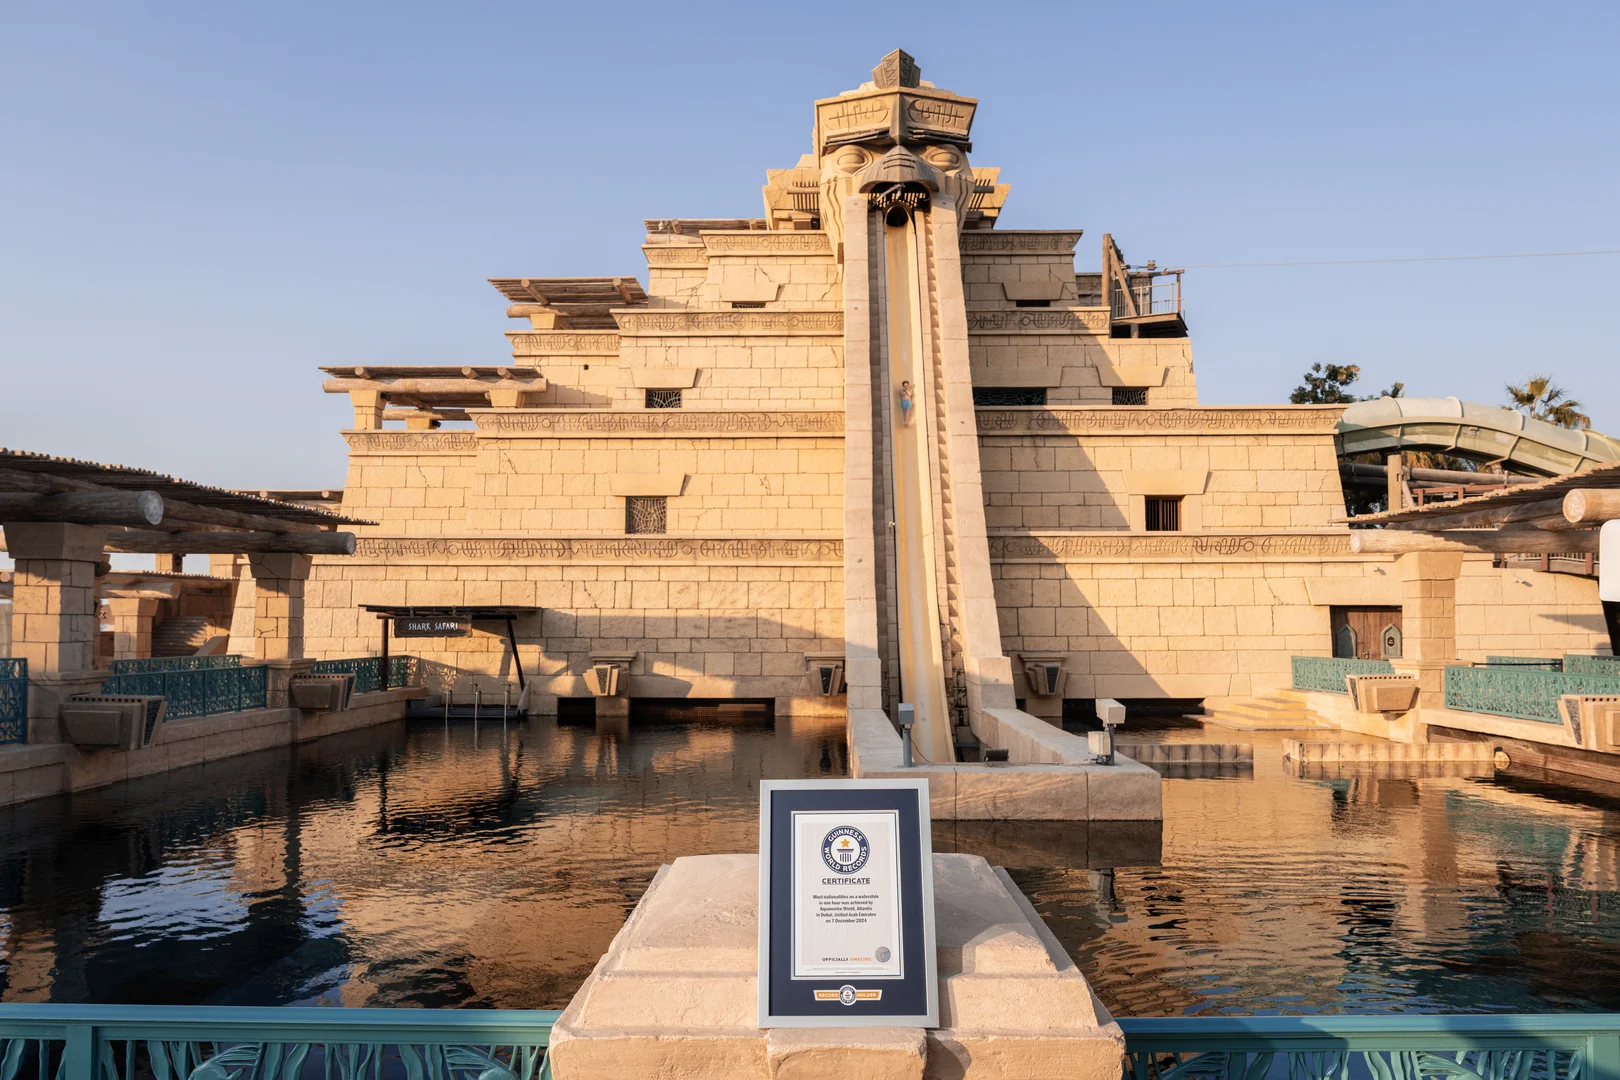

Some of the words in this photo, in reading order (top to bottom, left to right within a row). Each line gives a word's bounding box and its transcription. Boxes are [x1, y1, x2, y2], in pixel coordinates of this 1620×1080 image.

[408, 622, 431, 631] SHARK
[434, 622, 458, 630] SAFARI
[828, 828, 863, 842] GUINNESS
[824, 846, 840, 870] WORLD
[842, 846, 867, 872] RECORDS
